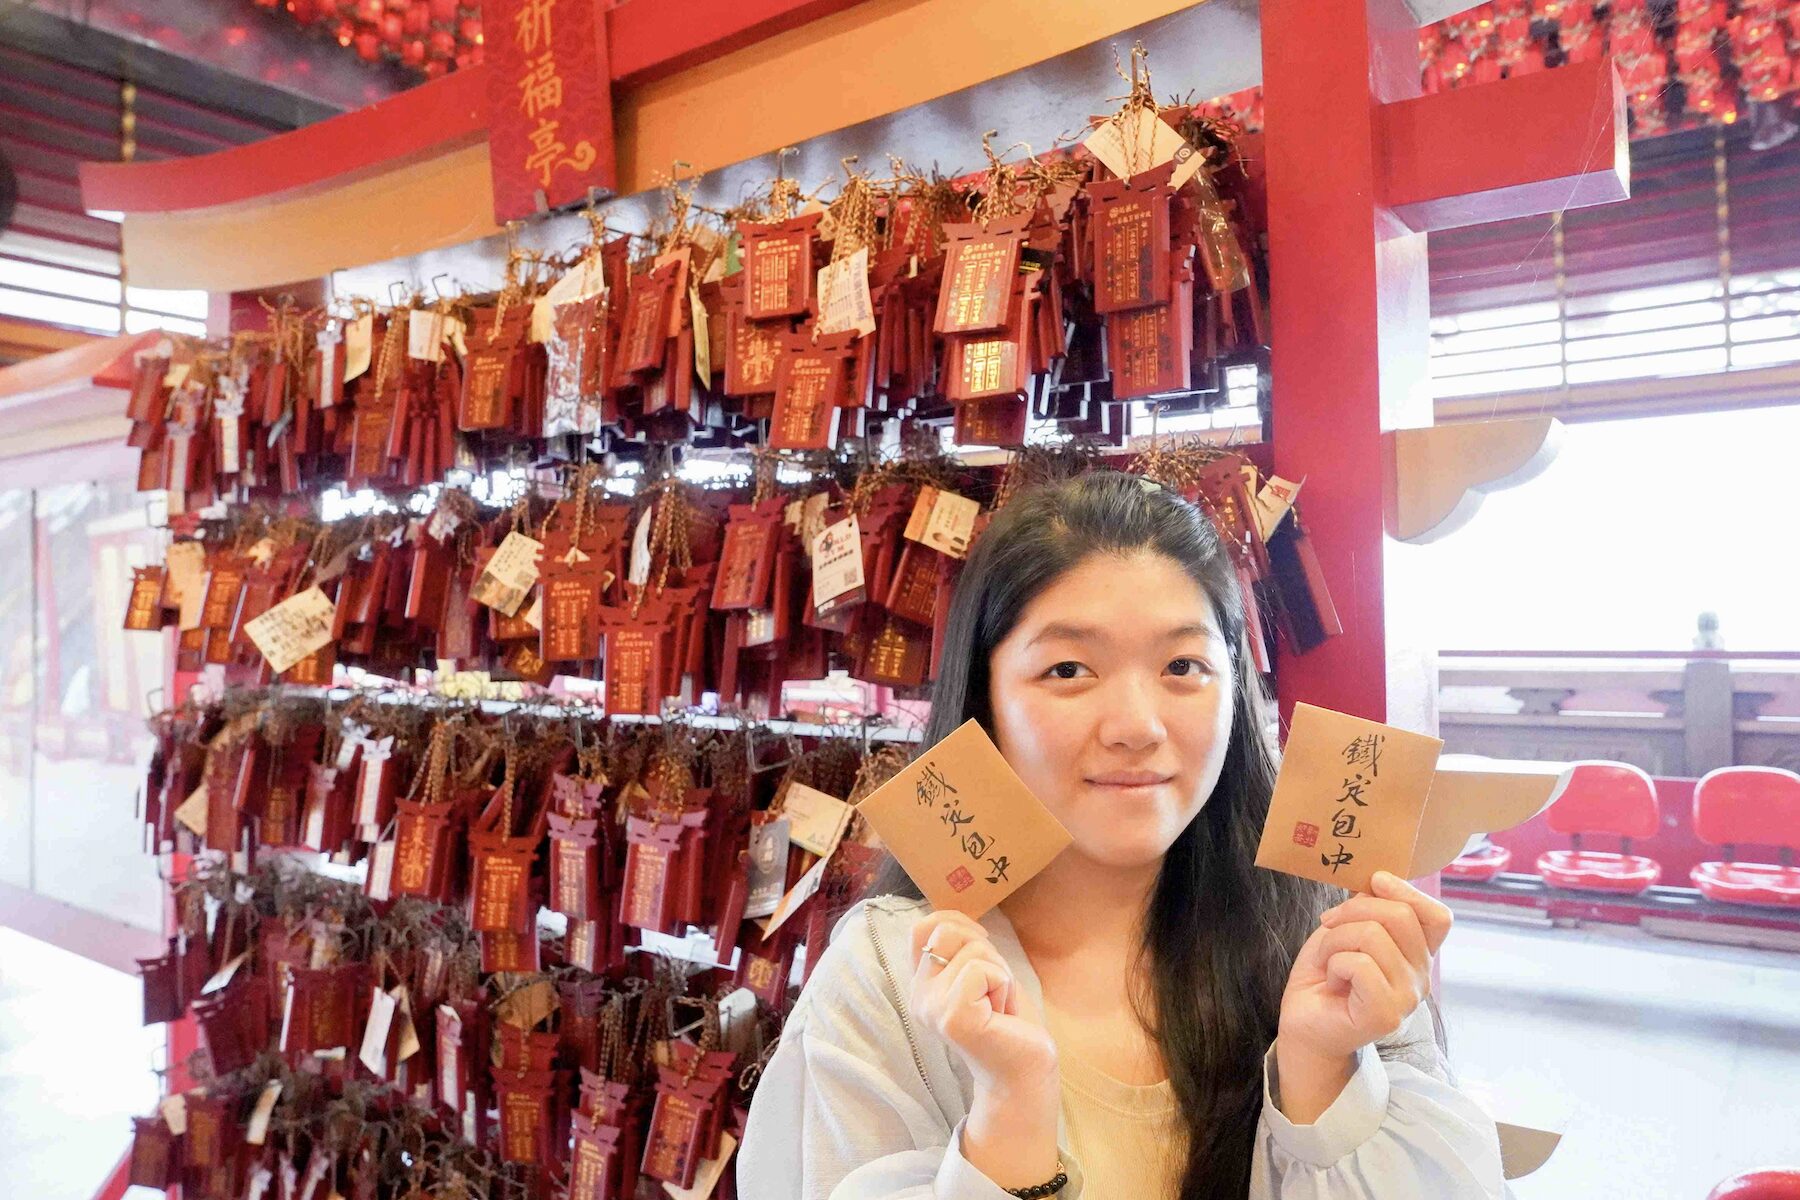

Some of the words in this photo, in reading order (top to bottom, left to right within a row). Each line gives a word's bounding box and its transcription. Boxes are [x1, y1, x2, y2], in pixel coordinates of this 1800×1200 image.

[515, 0, 566, 187] 祈福亭
[915, 761, 1011, 884] 鐵定包中
[1320, 734, 1386, 875] 鐵定包中
